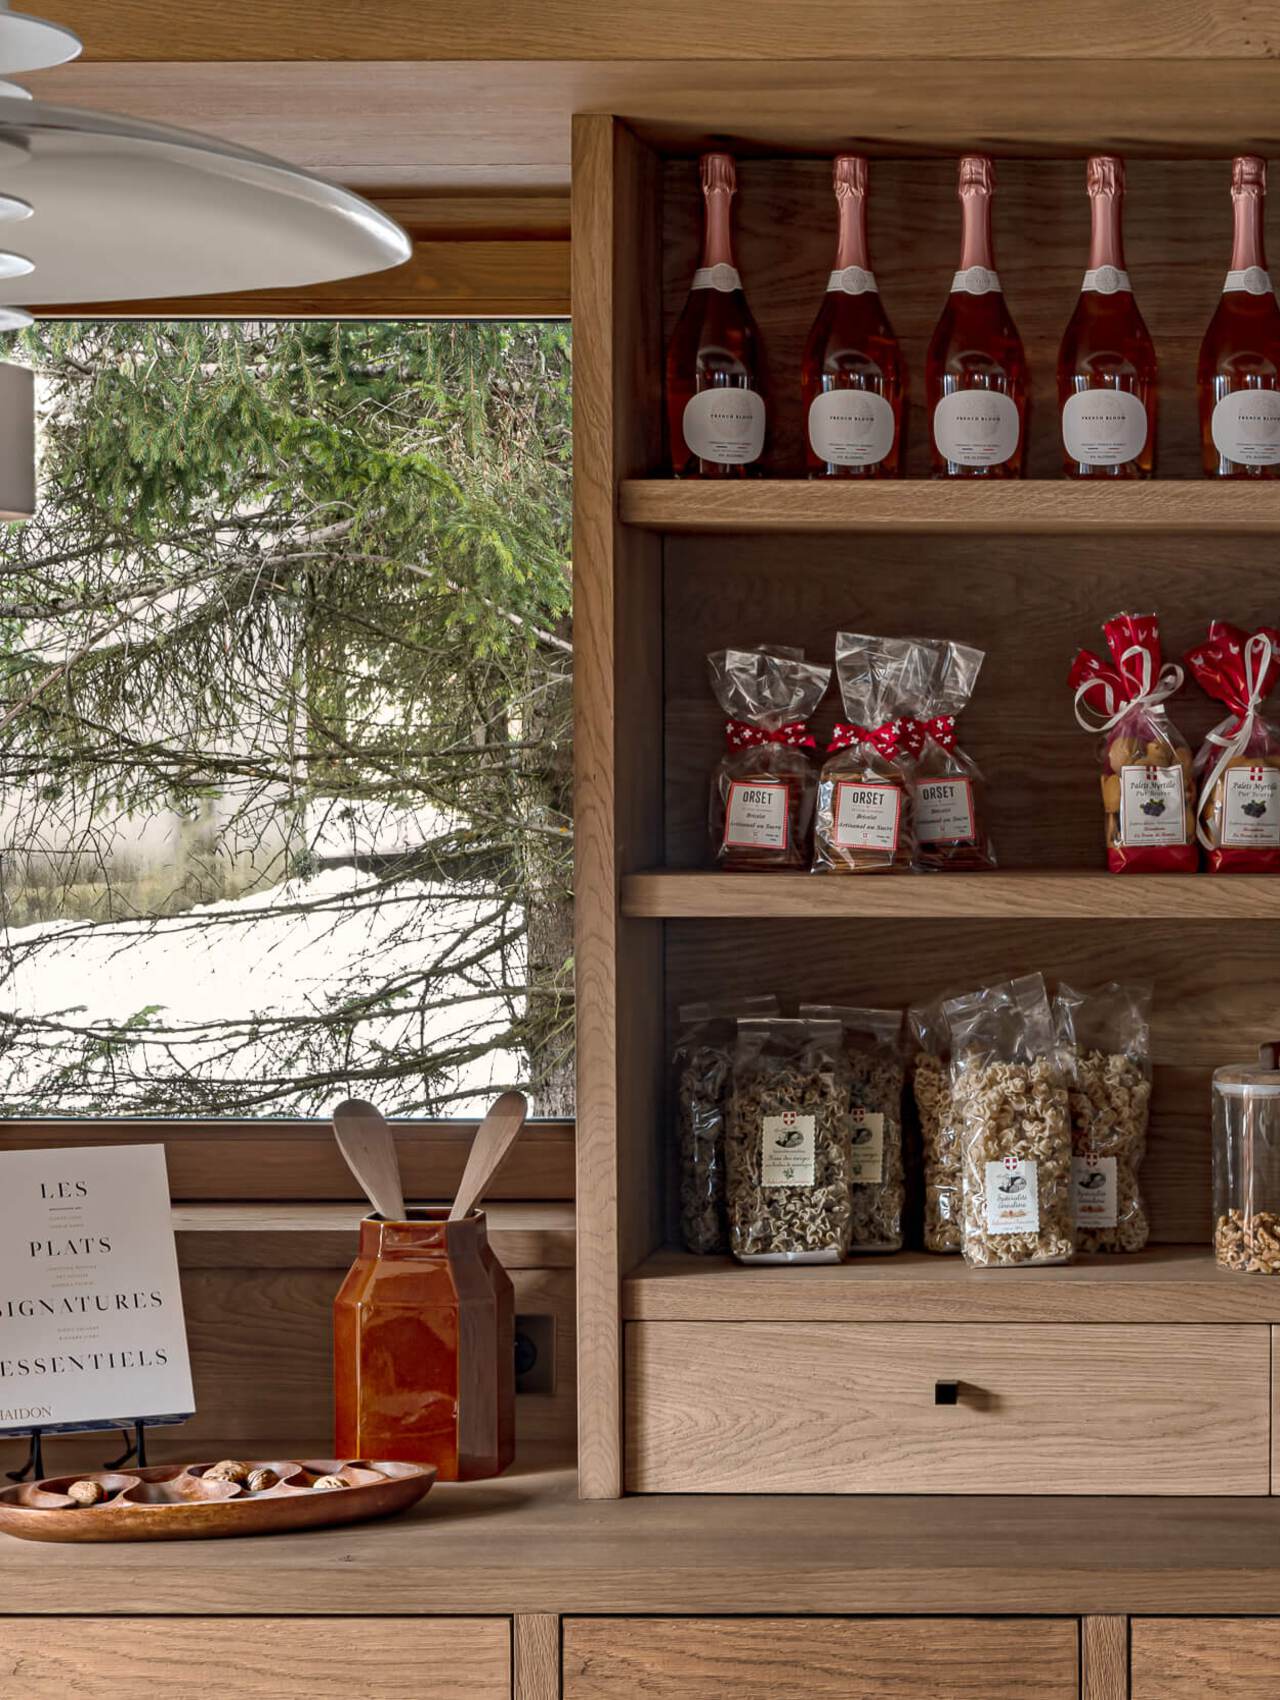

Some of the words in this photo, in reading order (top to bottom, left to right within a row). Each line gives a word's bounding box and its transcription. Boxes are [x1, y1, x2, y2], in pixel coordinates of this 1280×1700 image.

[743, 790, 774, 805] ORSET
[852, 791, 885, 806] ORSET
[922, 785, 955, 801] ORSET
[40, 1181, 88, 1199] LES
[29, 1237, 112, 1257] PLATS
[0, 1291, 163, 1319] IGNATURES
[1, 1348, 168, 1377] ESSENTIELS
